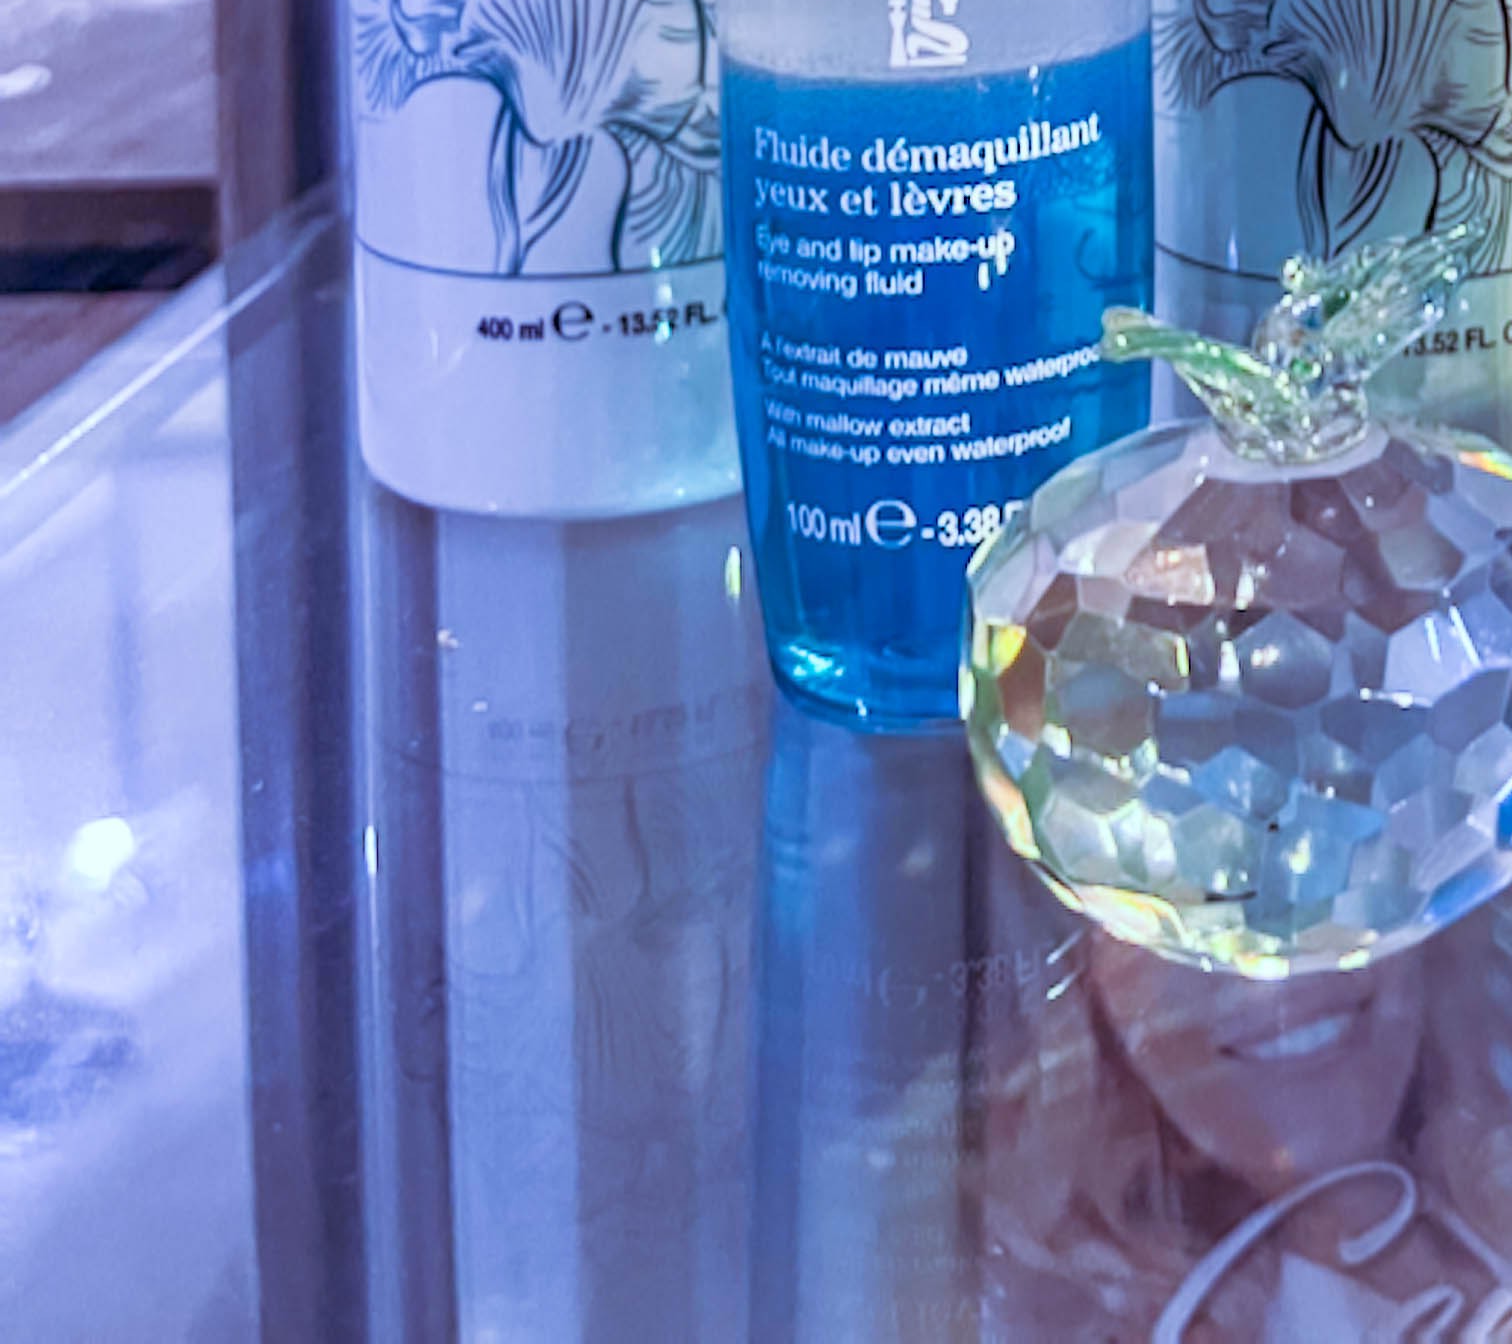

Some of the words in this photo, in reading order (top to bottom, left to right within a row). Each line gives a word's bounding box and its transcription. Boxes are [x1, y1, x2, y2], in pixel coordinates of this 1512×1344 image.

[754, 126, 852, 172] Fluide
[861, 112, 1101, 174] démaquillant
[754, 177, 829, 213] yeux
[840, 182, 878, 215] et
[890, 178, 1017, 216] lèvres
[755, 223, 790, 257] Eye
[797, 235, 841, 262] and
[849, 239, 881, 267] lip
[889, 230, 1015, 267] make-up
[758, 260, 857, 299] removing
[865, 268, 923, 296] fluid
[477, 317, 513, 340] 400
[520, 318, 544, 340] ml
[764, 358, 796, 386] Tout
[802, 370, 917, 402] maquillage
[924, 370, 1000, 396] même
[1005, 343, 1100, 388] waterproo
[847, 347, 877, 368] de
[884, 346, 968, 370] mauve
[765, 398, 800, 421] With
[806, 412, 884, 437] mallow
[889, 412, 970, 438] extract
[767, 426, 785, 449] All
[790, 433, 880, 467] make-up
[887, 445, 945, 465] even
[950, 417, 1071, 462] waterproof
[787, 503, 826, 541] 100
[830, 513, 861, 545] ml
